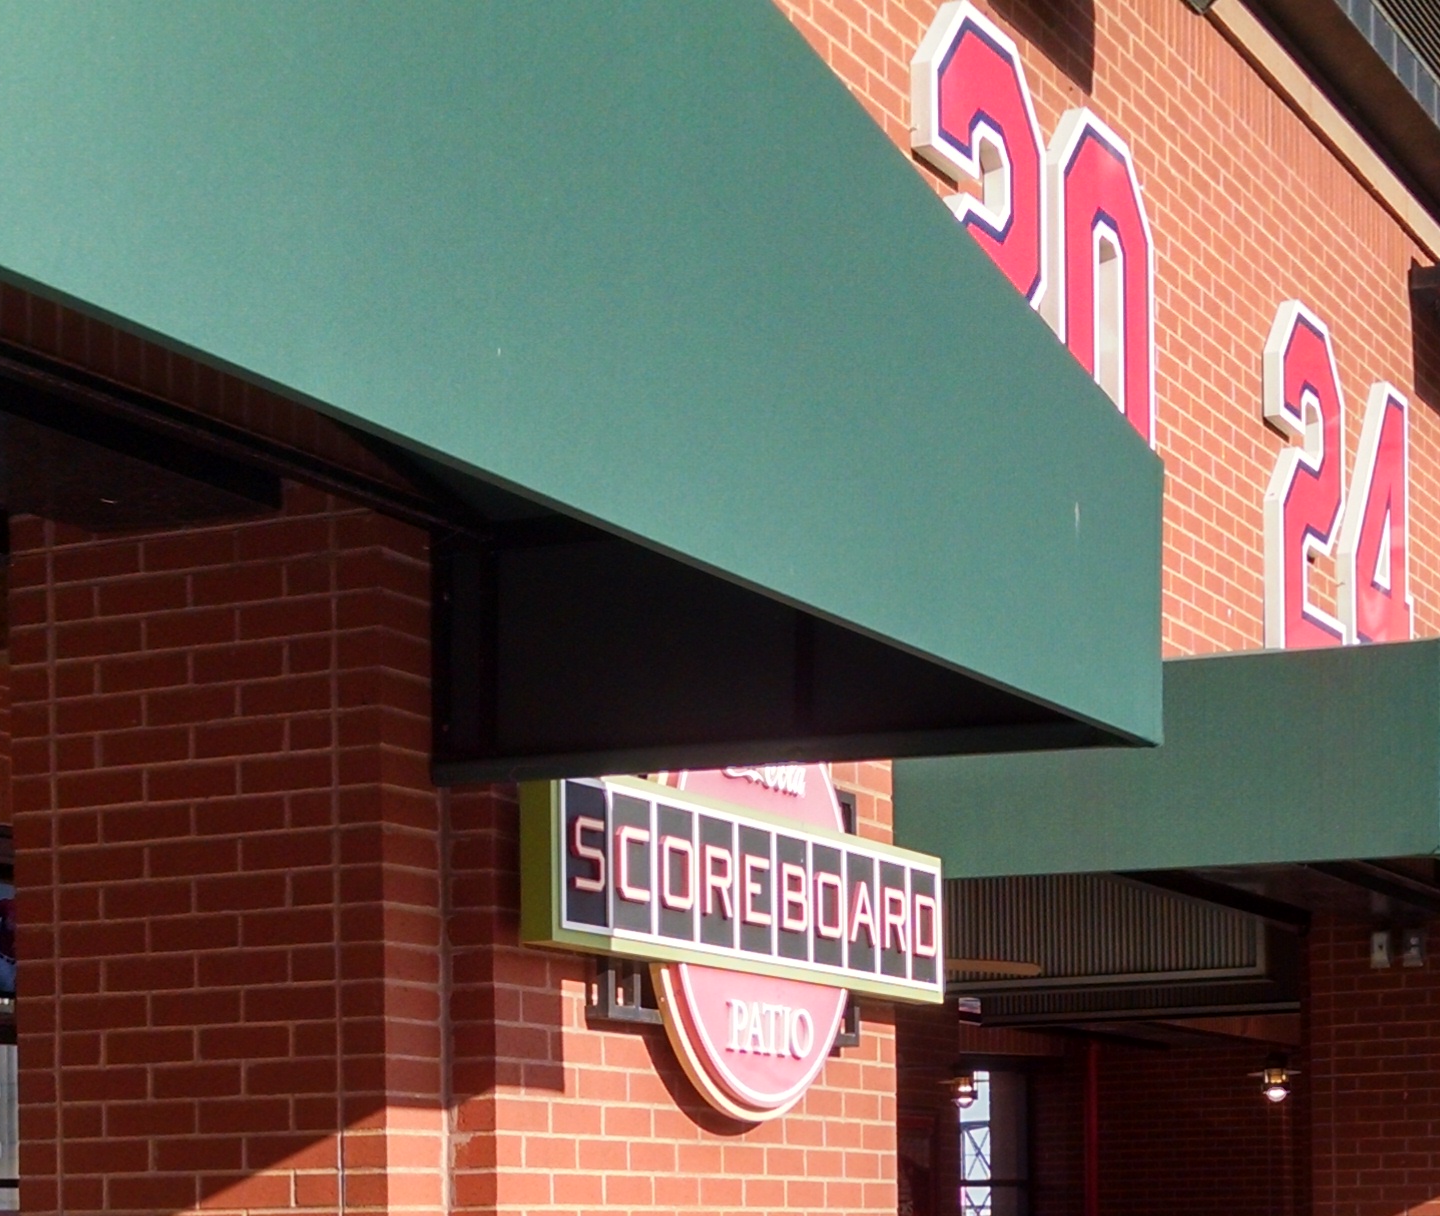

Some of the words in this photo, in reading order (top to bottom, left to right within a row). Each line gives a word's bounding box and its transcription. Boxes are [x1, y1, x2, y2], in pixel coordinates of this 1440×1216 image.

[912, 0, 1156, 451] 20
[1263, 300, 1413, 648] 24
[570, 815, 939, 957] SCOREBOARD
[726, 998, 814, 1060] PATIO
